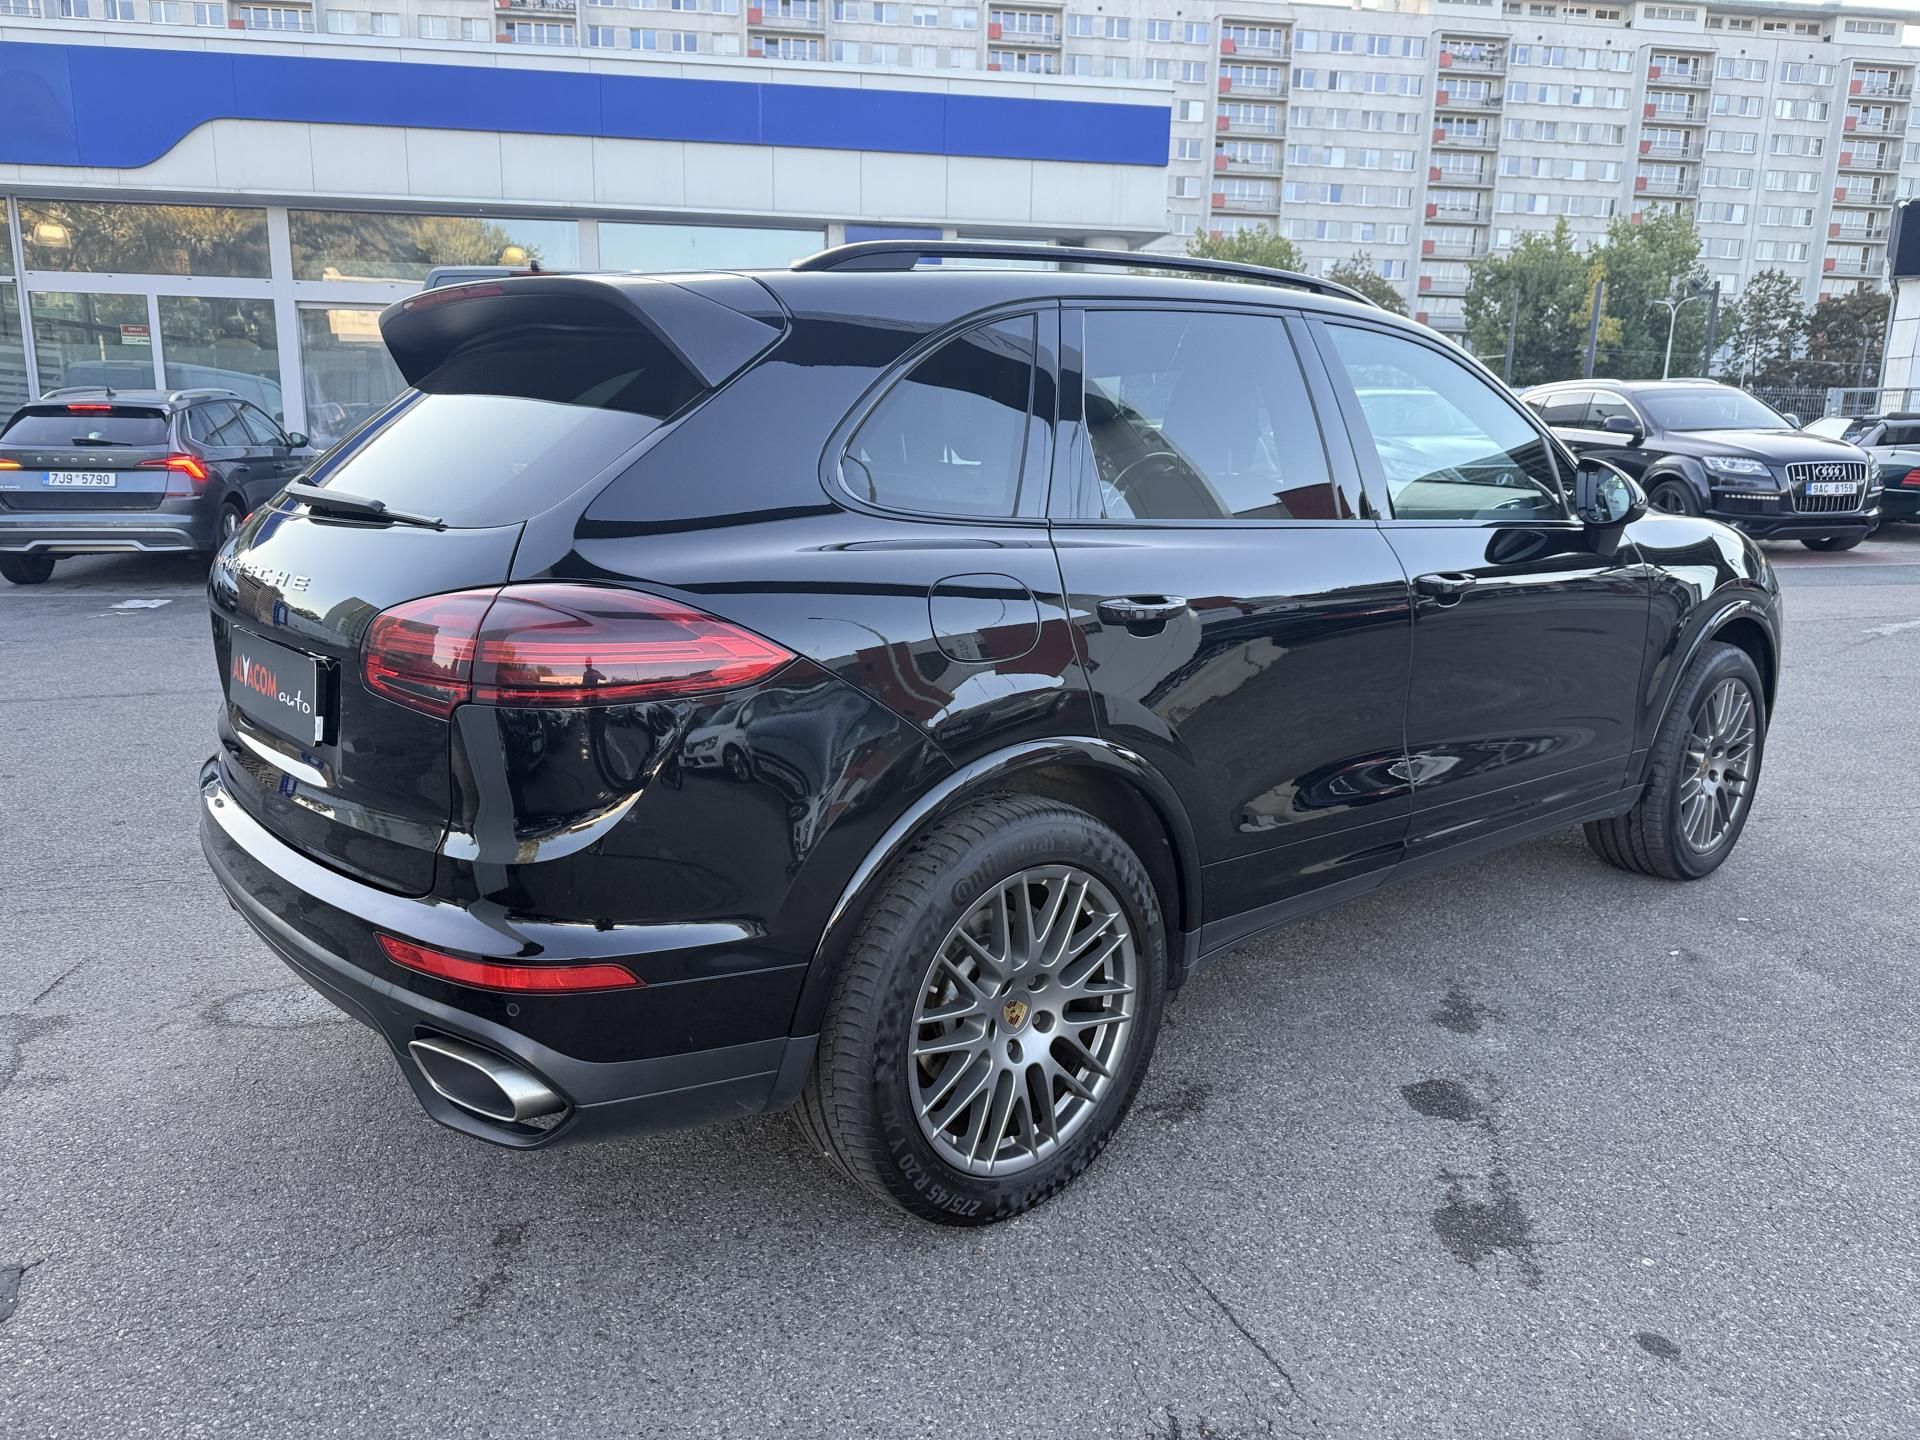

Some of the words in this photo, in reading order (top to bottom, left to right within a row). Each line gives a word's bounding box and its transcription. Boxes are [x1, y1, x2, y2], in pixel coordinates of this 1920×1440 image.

[51, 473, 73, 484] 7J9
[81, 473, 110, 485] 5790
[1813, 484, 1829, 493] 9AC
[1834, 483, 1854, 493] 8159
[278, 690, 311, 714] auto
[925, 1183, 982, 1217] 275/45
